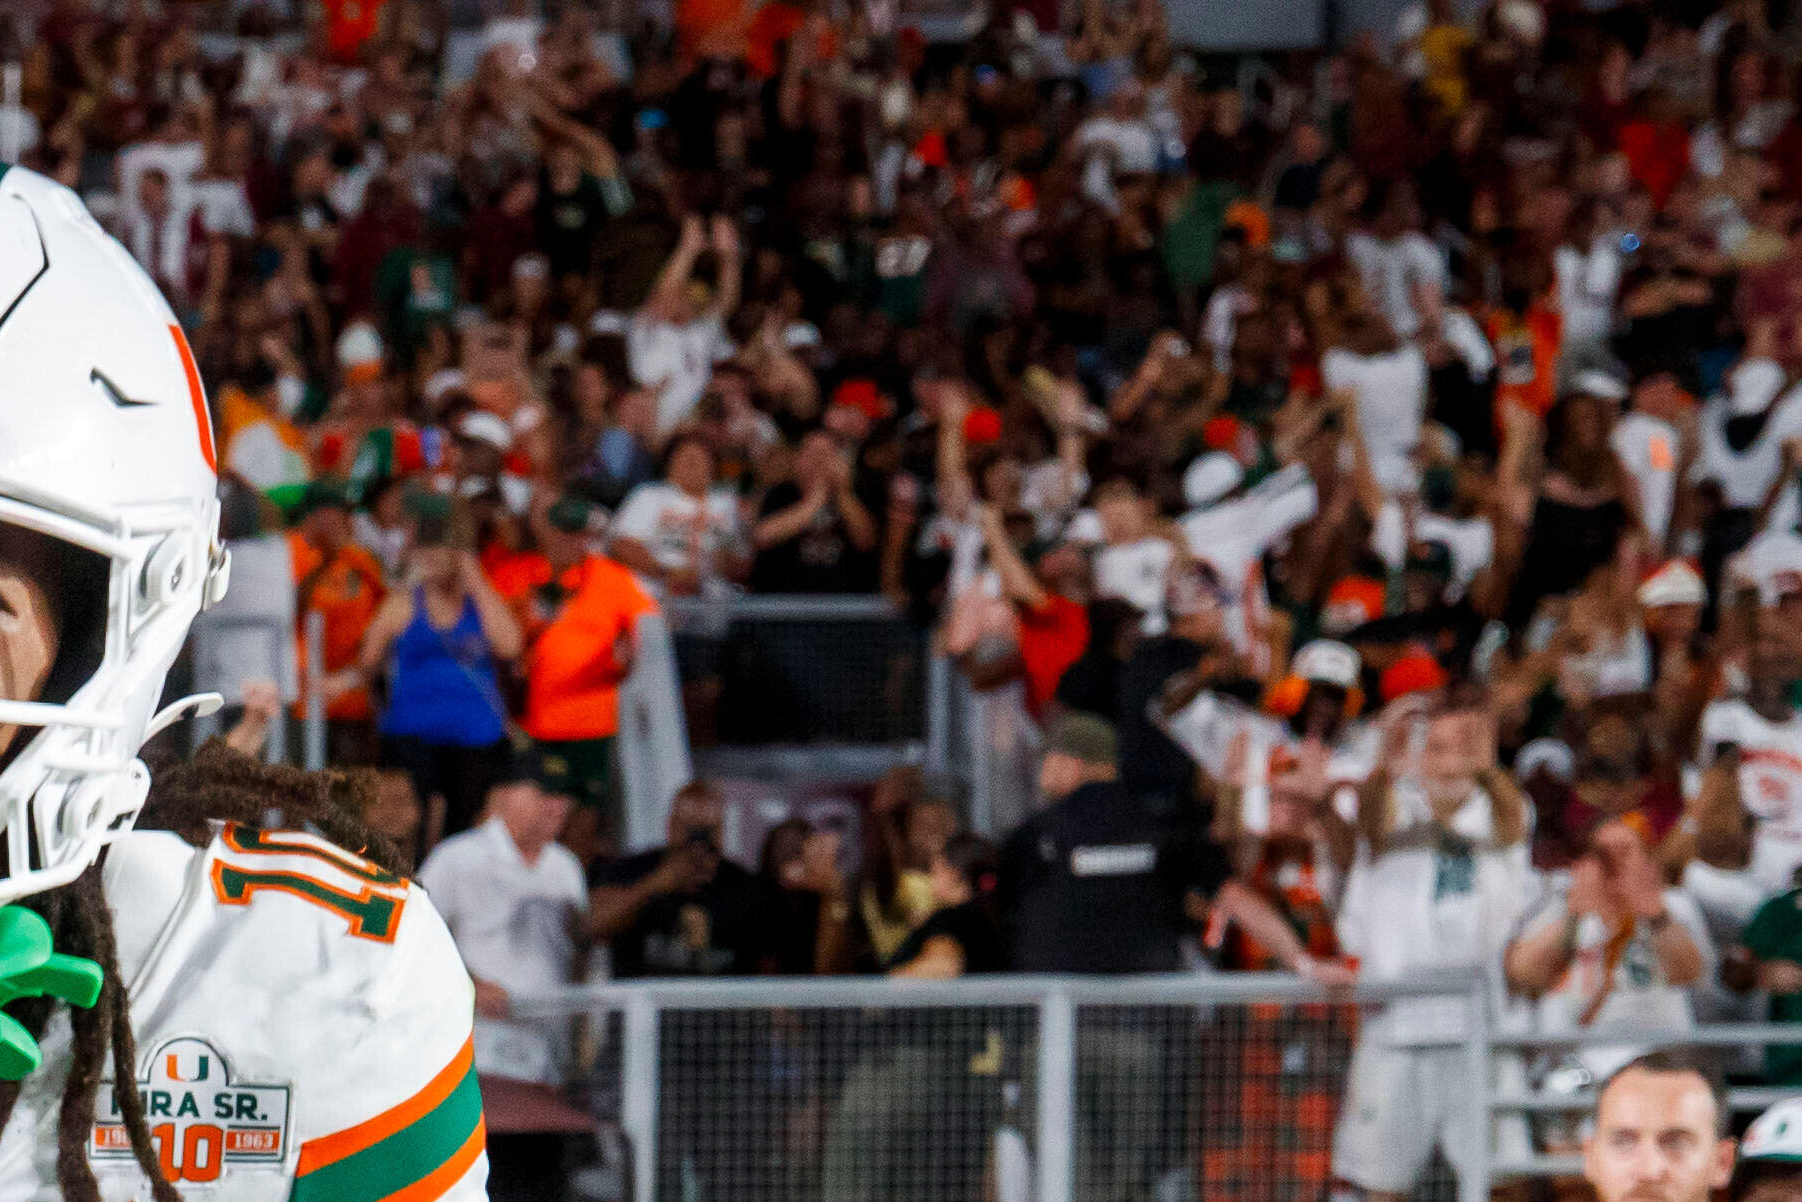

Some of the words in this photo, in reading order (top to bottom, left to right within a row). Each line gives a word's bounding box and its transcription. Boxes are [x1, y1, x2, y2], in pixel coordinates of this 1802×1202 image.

[167, 1054, 209, 1082] U
[214, 1092, 268, 1121] SR.
[152, 1122, 224, 1183] 10
